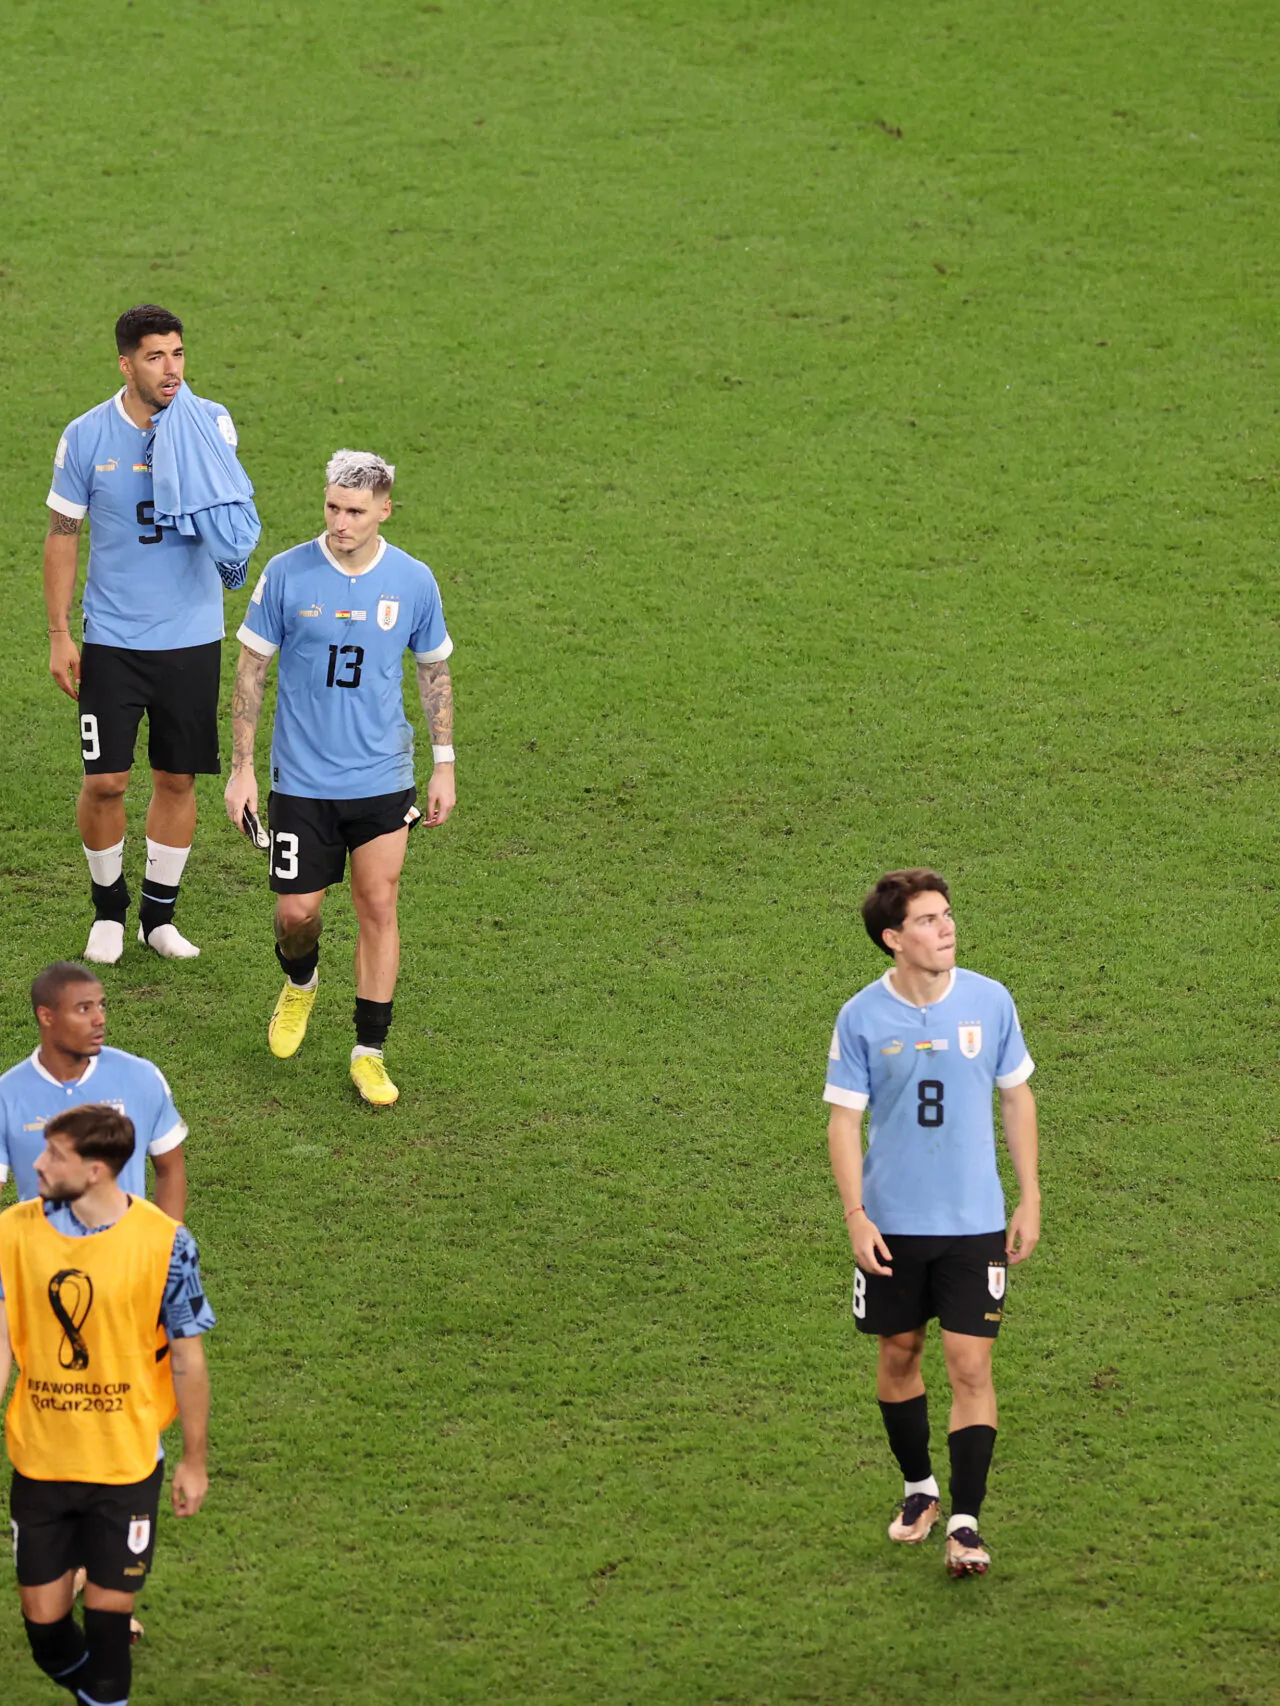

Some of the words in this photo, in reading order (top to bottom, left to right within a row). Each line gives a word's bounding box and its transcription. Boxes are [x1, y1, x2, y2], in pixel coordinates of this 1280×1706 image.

[136, 500, 163, 545] 9
[326, 644, 365, 689] 13
[81, 713, 101, 760] 9
[269, 829, 299, 879] 13
[917, 1079, 945, 1128] 8
[852, 1267, 866, 1319] 8
[104, 1383, 131, 1395] CUP
